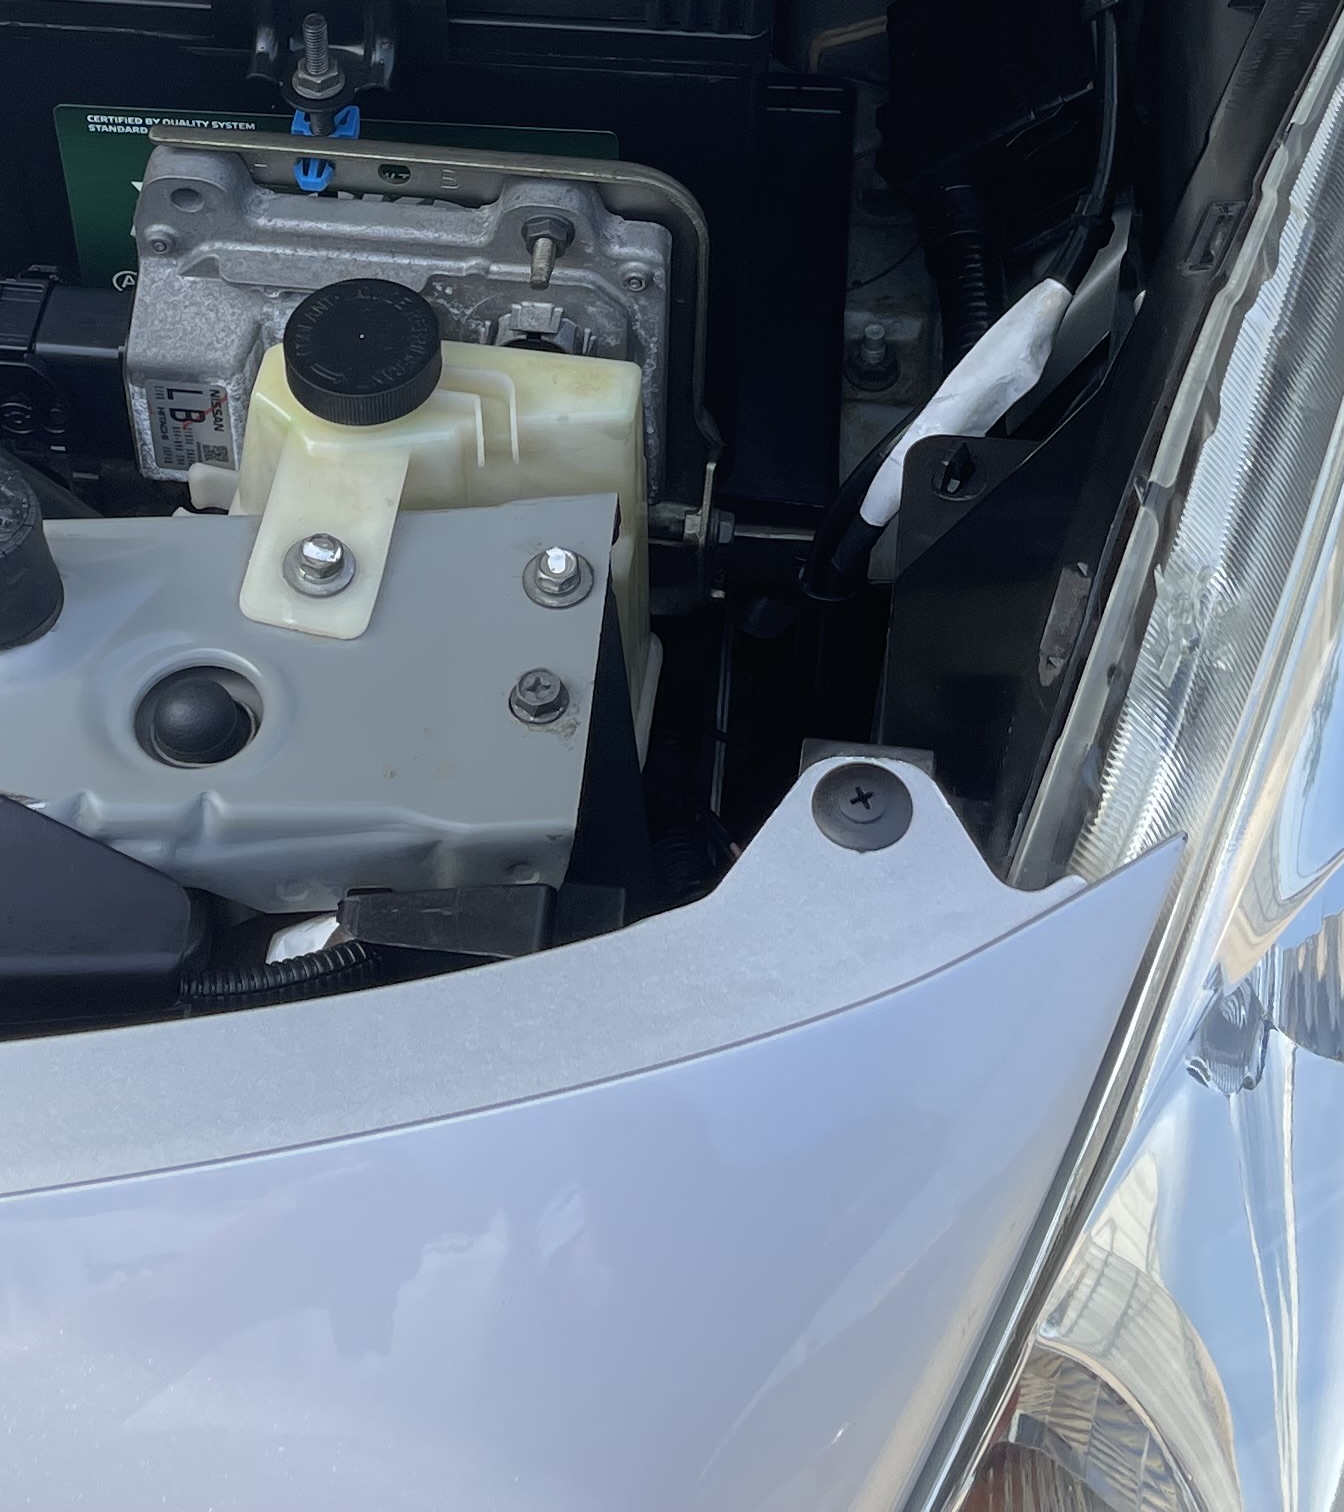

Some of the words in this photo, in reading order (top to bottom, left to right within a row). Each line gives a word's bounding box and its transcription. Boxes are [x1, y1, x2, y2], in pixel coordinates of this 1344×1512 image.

[86, 114, 143, 125] CERTIFIED
[145, 117, 160, 125] BY
[162, 118, 210, 128] QUALITY
[211, 120, 256, 131] SYSTEM
[87, 123, 149, 135] STANDARD
[209, 388, 224, 432] NISSAN
[157, 406, 169, 441] HITACHI
